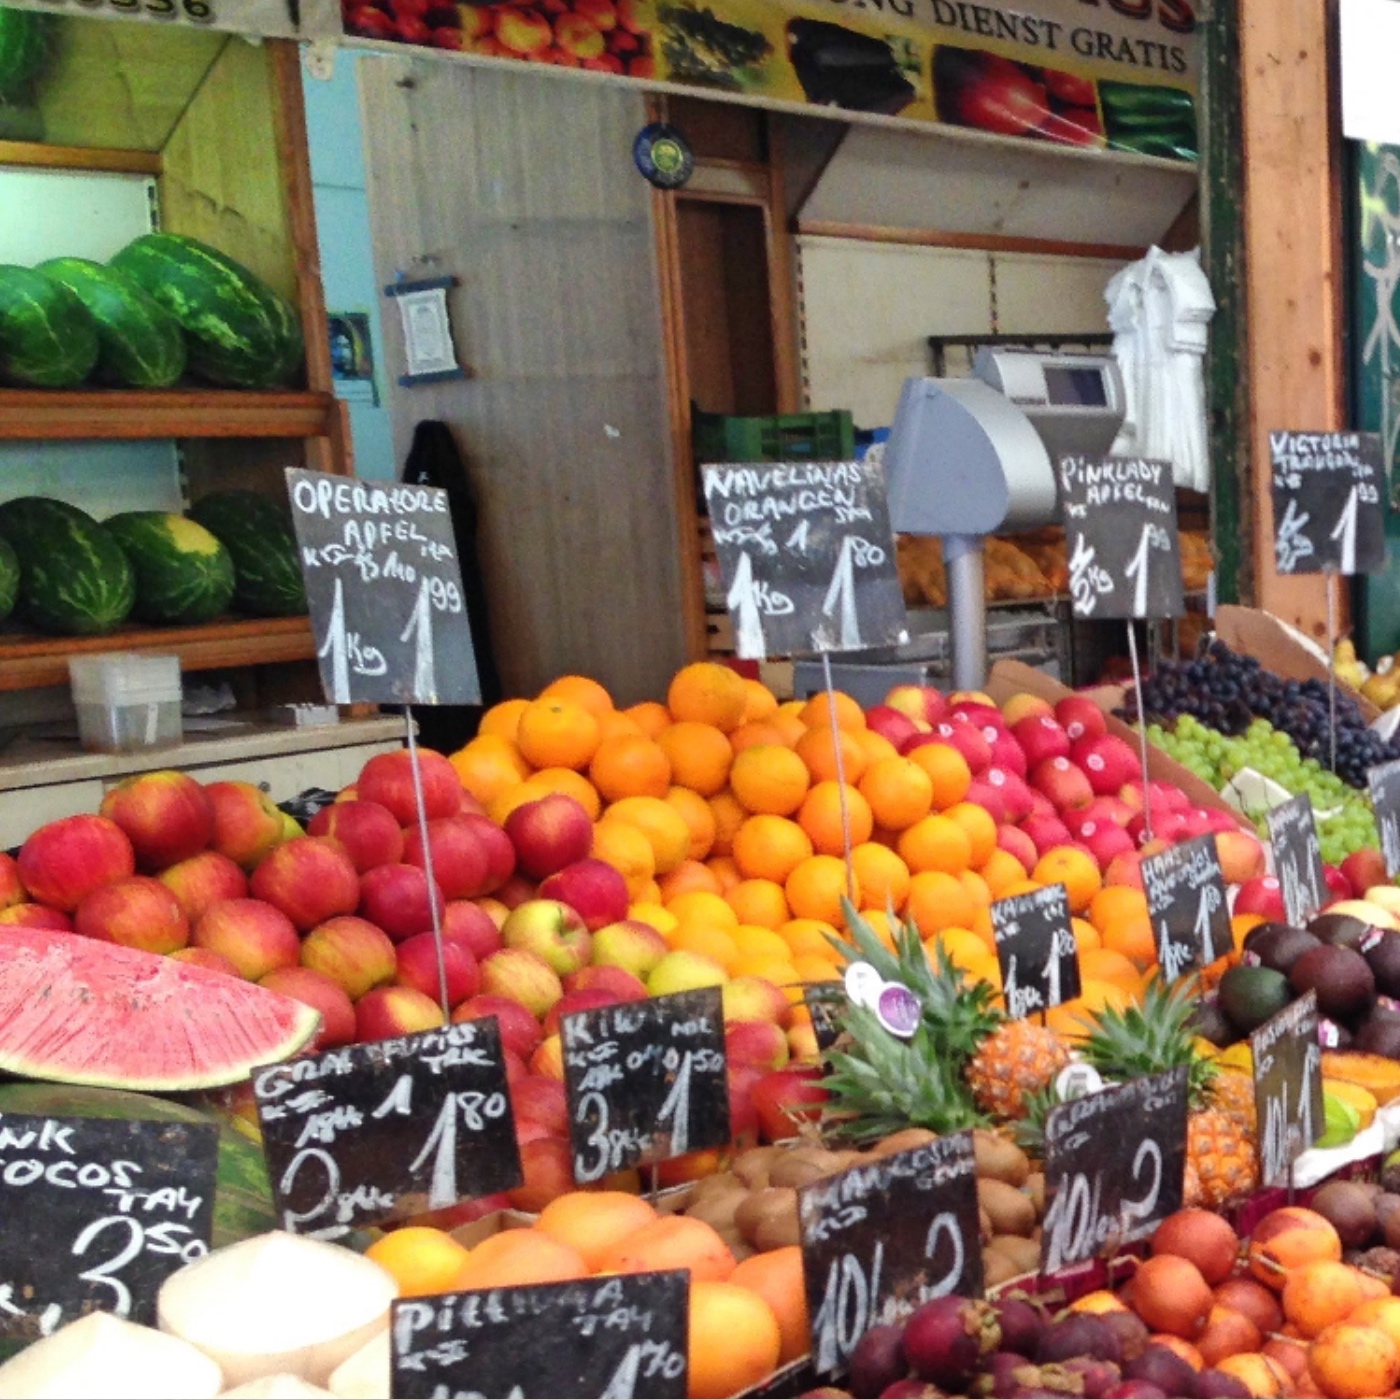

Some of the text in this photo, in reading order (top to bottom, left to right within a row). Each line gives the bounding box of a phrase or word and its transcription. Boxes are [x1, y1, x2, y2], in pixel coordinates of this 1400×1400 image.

[929, 0, 1062, 50] DIENST
[1069, 26, 1188, 74] GRATIS
[724, 487, 857, 526] ORANGEN
[344, 519, 428, 553] APFEL
[0, 1158, 143, 1189] OCOS
